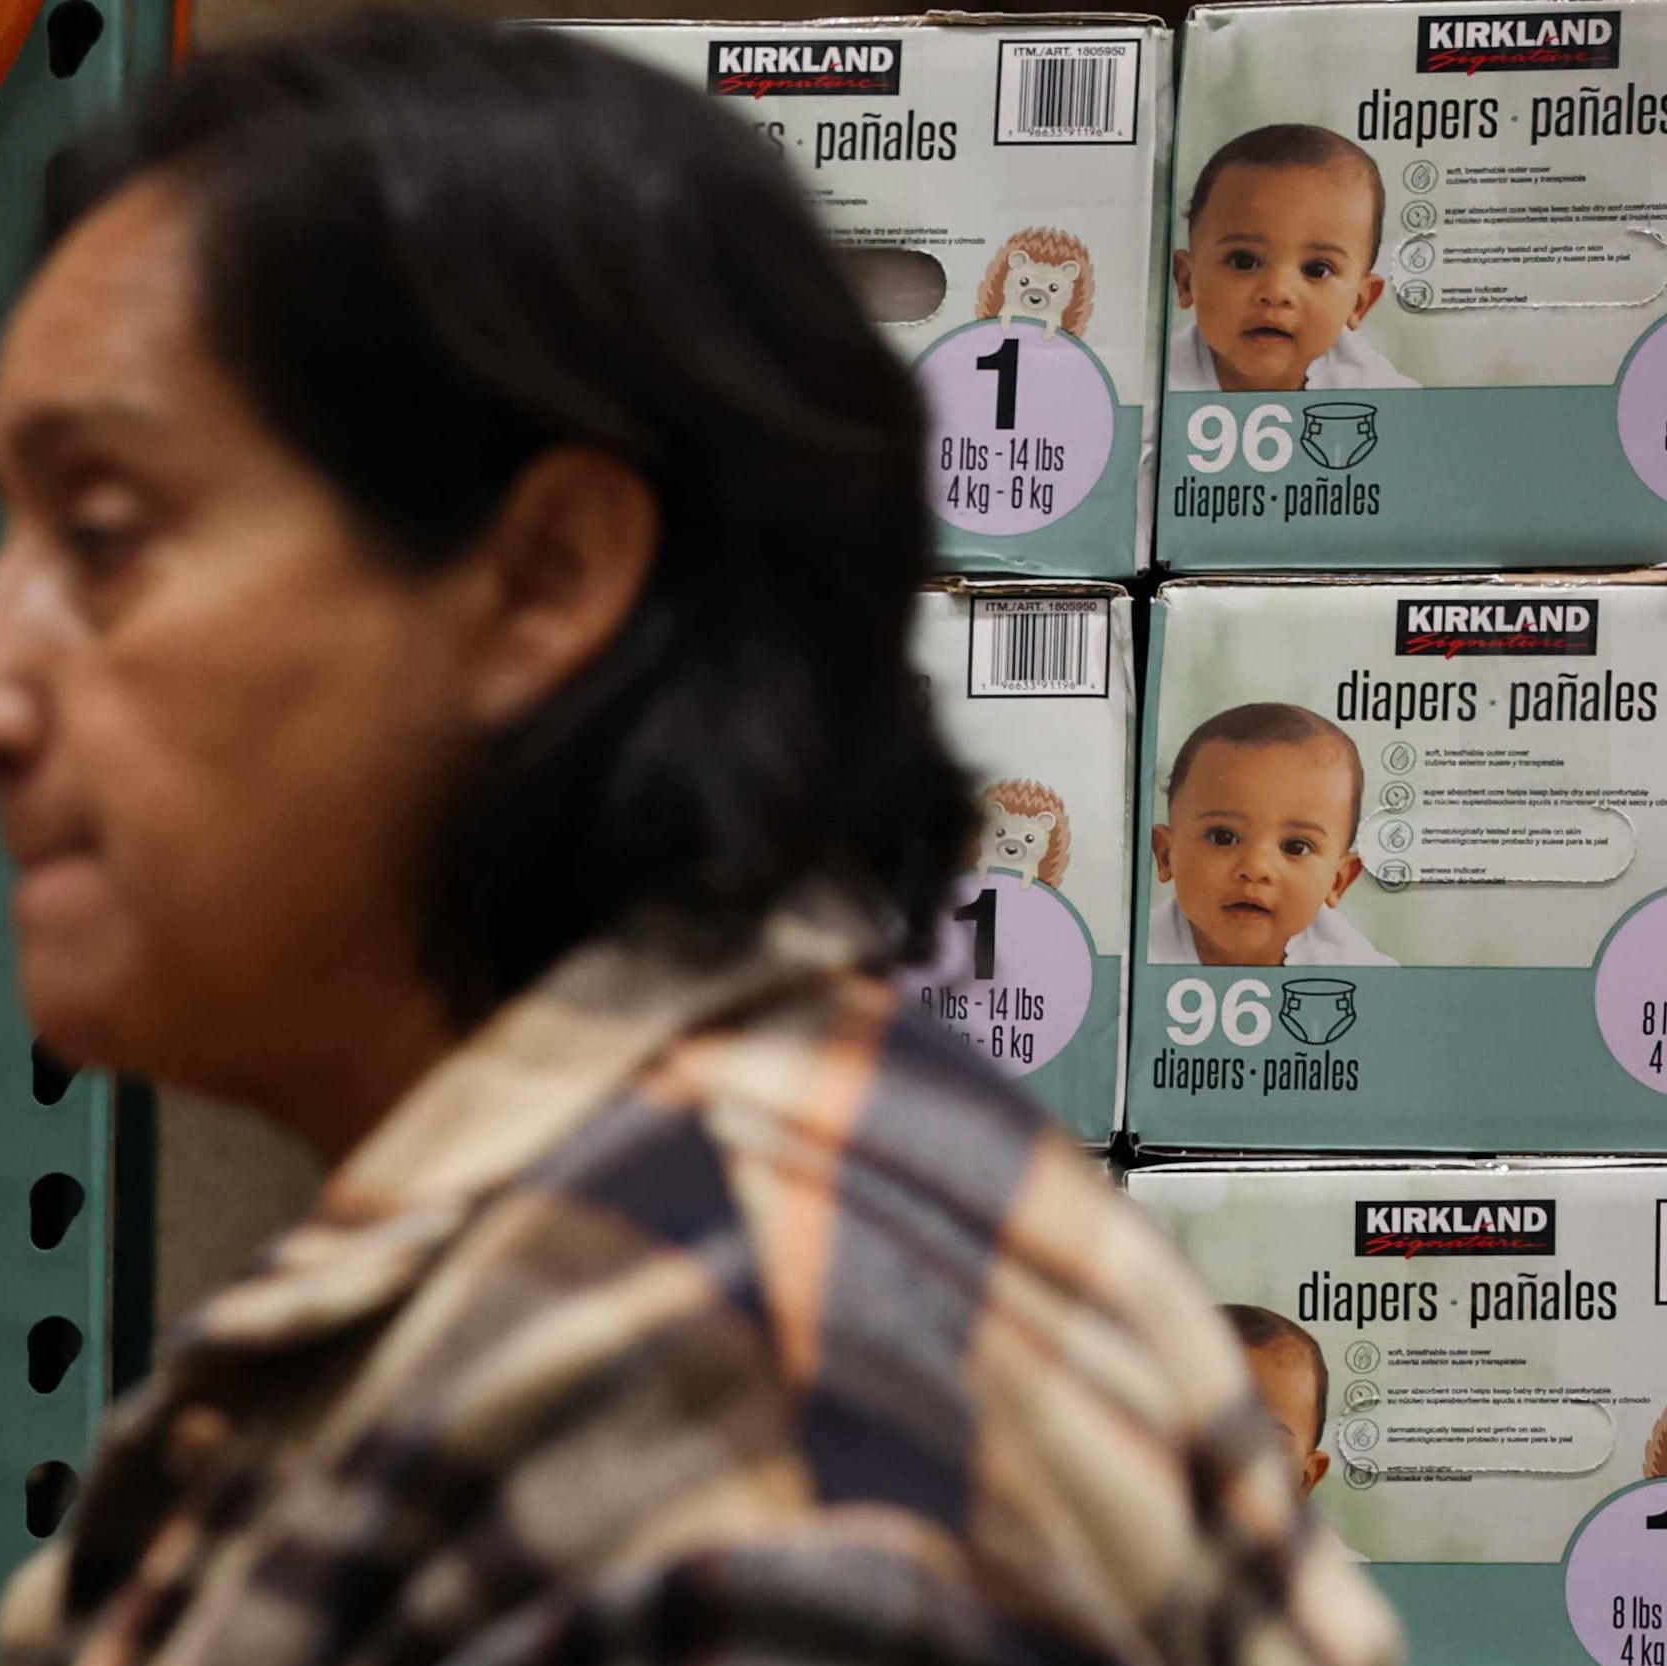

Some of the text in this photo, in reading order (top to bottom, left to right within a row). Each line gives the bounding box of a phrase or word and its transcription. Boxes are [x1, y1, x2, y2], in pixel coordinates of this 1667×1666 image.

[1429, 17, 1613, 49] KIRKLAND
[718, 46, 894, 73] KIRKLAND
[1428, 47, 1608, 75] Signature
[719, 74, 891, 98] Signature
[1358, 88, 1498, 147] diapers
[815, 110, 957, 168] pañales
[976, 338, 1020, 430] 1
[940, 437, 1065, 472] 8 lbs 14 lbs
[1186, 403, 1293, 473] 96
[947, 476, 1054, 515] 4 kg 6 kg
[1174, 476, 1380, 523] diapers pañales
[1049, 602, 1097, 612] 1805950
[1407, 604, 1591, 634] KIRKLAND
[1407, 632, 1589, 659] Signature
[1336, 670, 1658, 729] diapers pañales
[953, 888, 998, 981] 1
[988, 987, 1010, 1022] 14
[1013, 986, 1045, 1023] lbs
[1166, 977, 1273, 1048] 96
[1642, 1001, 1655, 1036] 8
[991, 1023, 1035, 1064] 6 kg
[1649, 1040, 1663, 1074] 4
[1153, 1049, 1359, 1098] diapers pañales
[1367, 1206, 1548, 1234] KIRKLAND
[1366, 1233, 1547, 1260] Signature
[1298, 1270, 1617, 1329] diapers pañales
[1612, 1596, 1663, 1630] 8 lbs
[1621, 1635, 1634, 1666] 4
